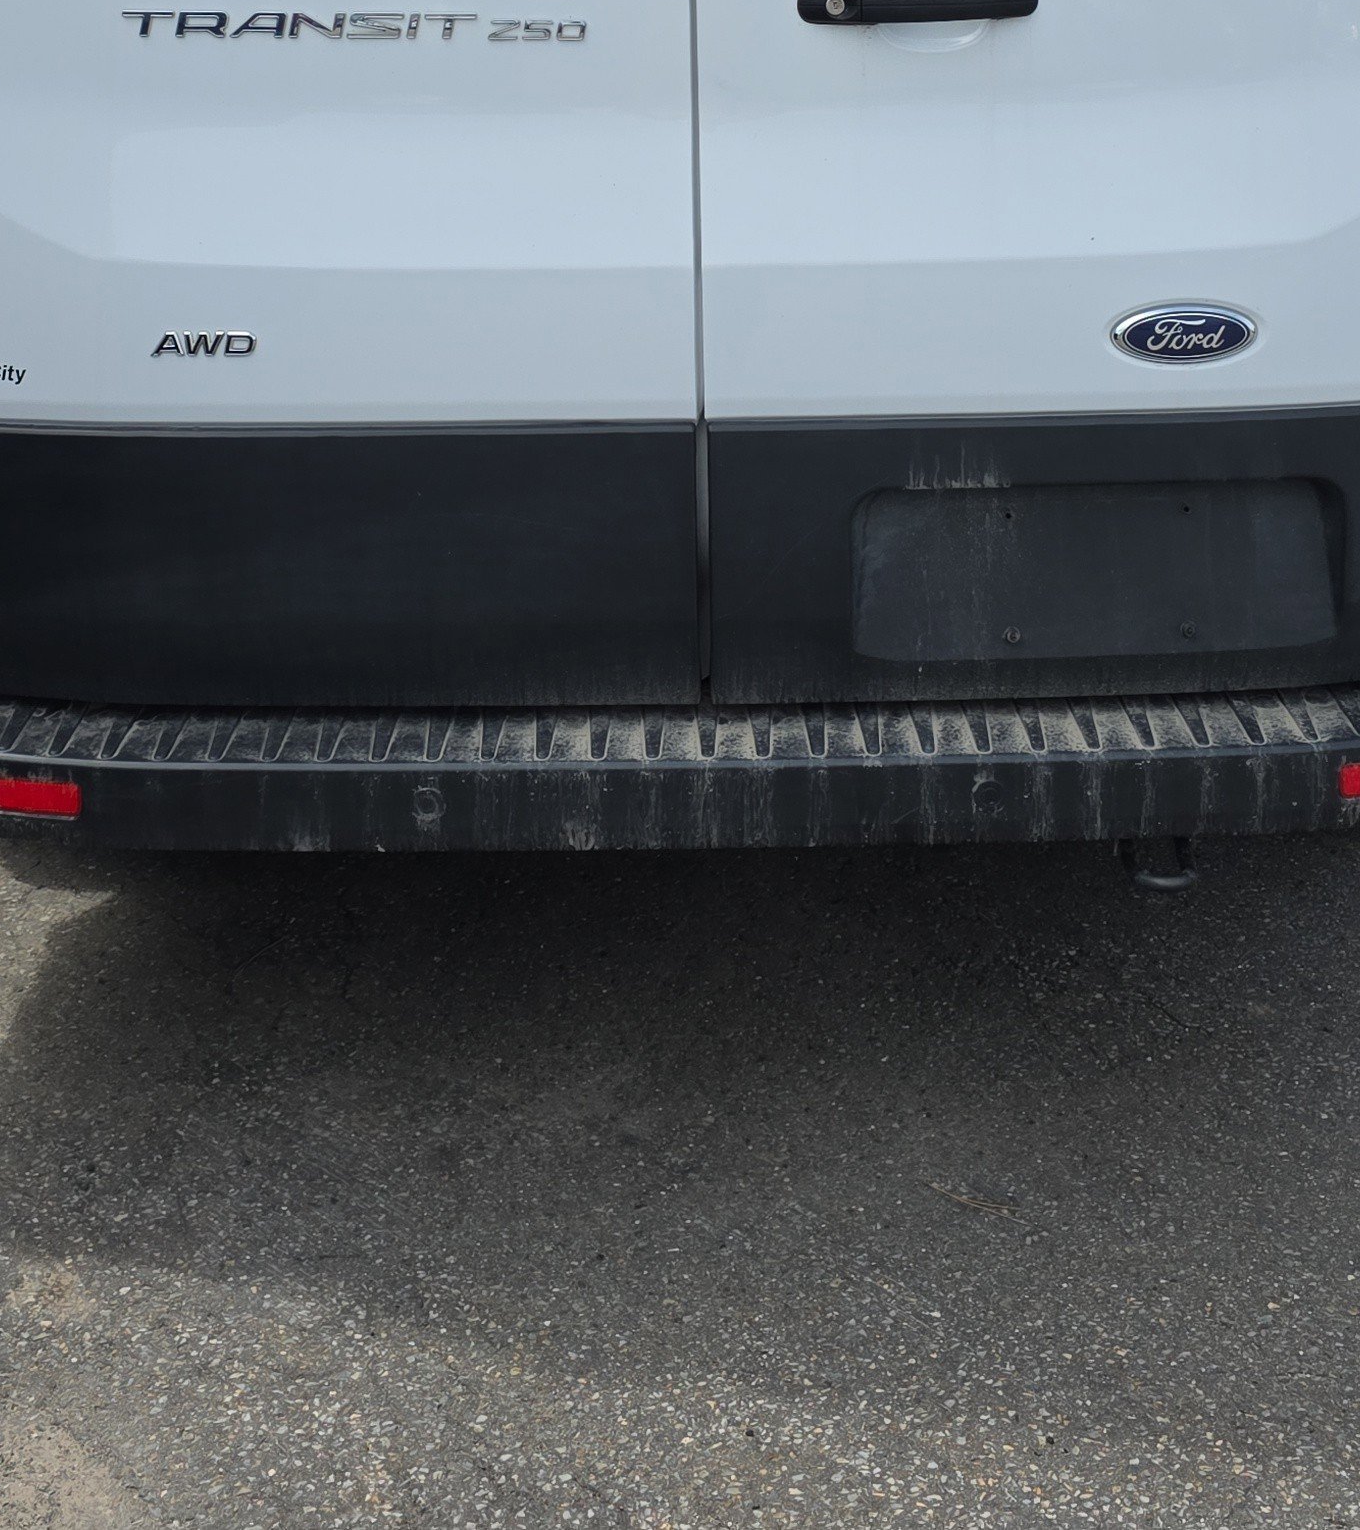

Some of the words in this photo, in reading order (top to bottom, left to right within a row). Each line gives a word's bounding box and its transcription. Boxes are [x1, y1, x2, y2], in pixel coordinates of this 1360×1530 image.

[122, 9, 478, 40] TRANSIT
[487, 19, 586, 42] 250
[151, 330, 258, 358] AWD
[1146, 318, 1226, 351] Ford
